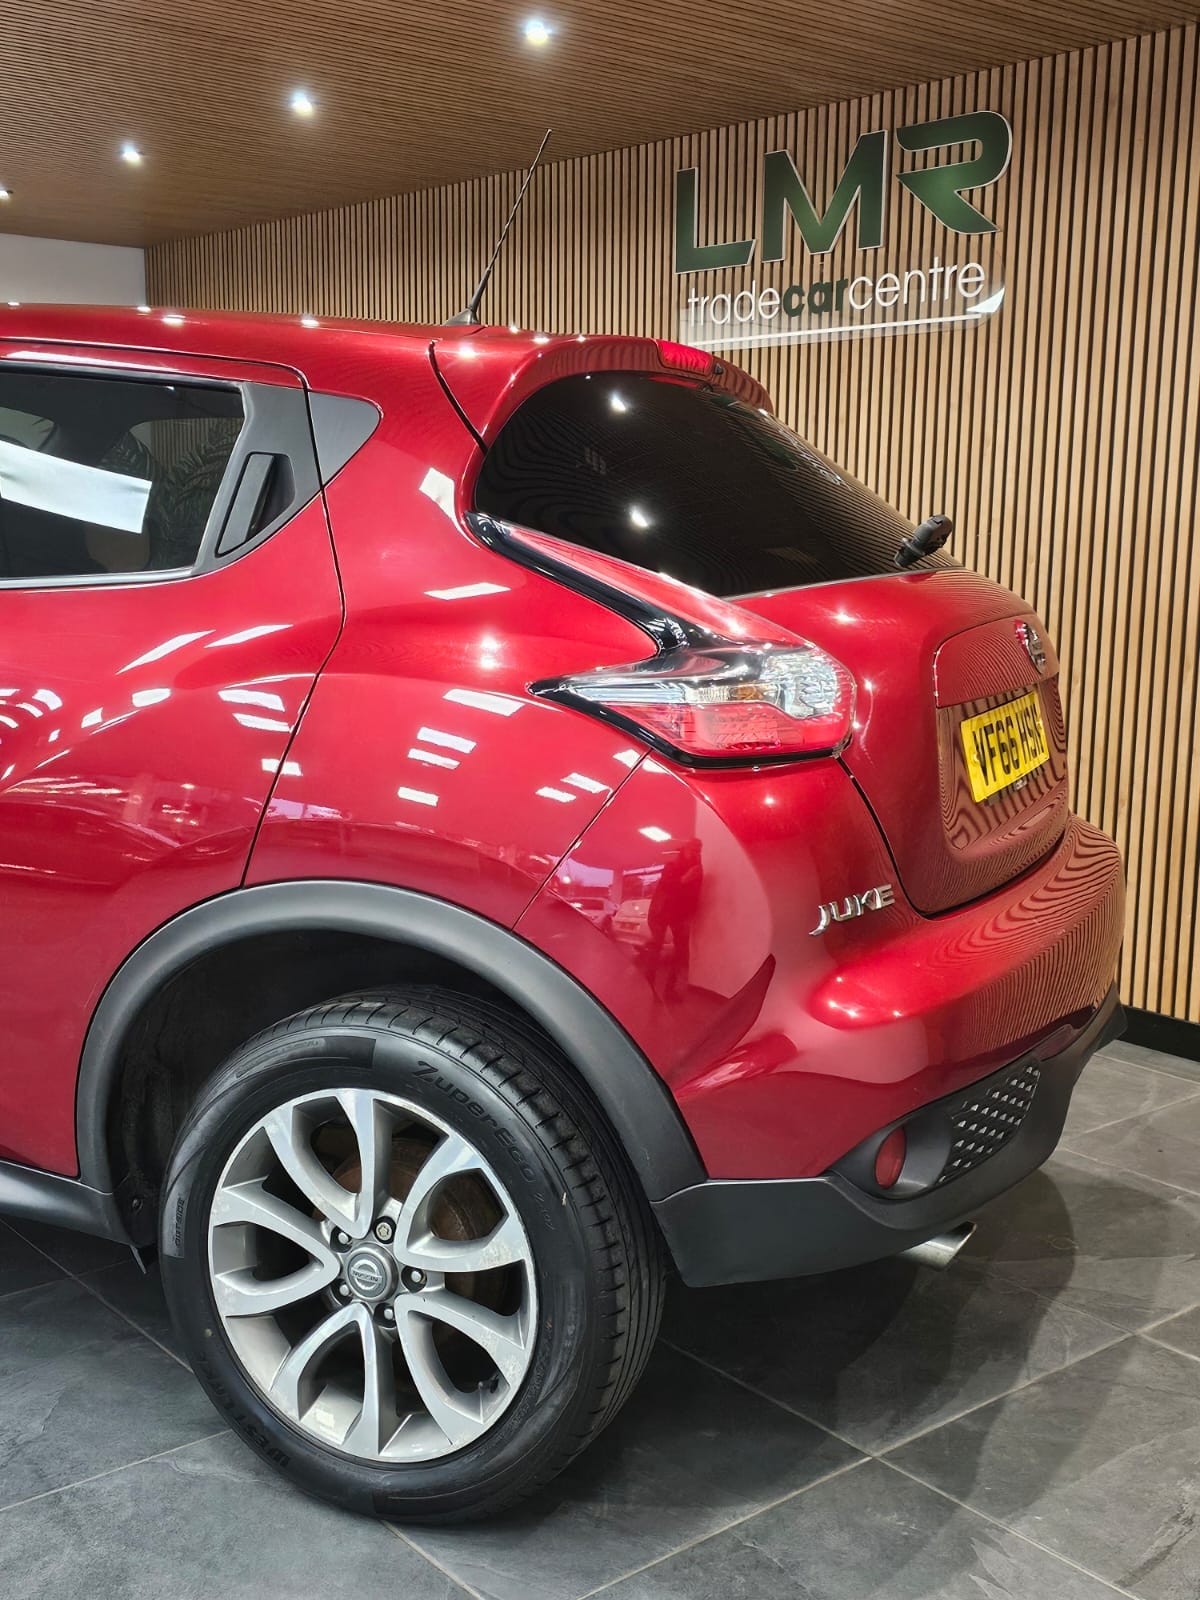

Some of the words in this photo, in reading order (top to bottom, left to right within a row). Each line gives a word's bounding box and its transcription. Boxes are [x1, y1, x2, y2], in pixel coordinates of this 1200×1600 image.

[674, 109, 1013, 275] LMR
[972, 715, 1020, 786] VF66
[808, 883, 895, 936] JUKE
